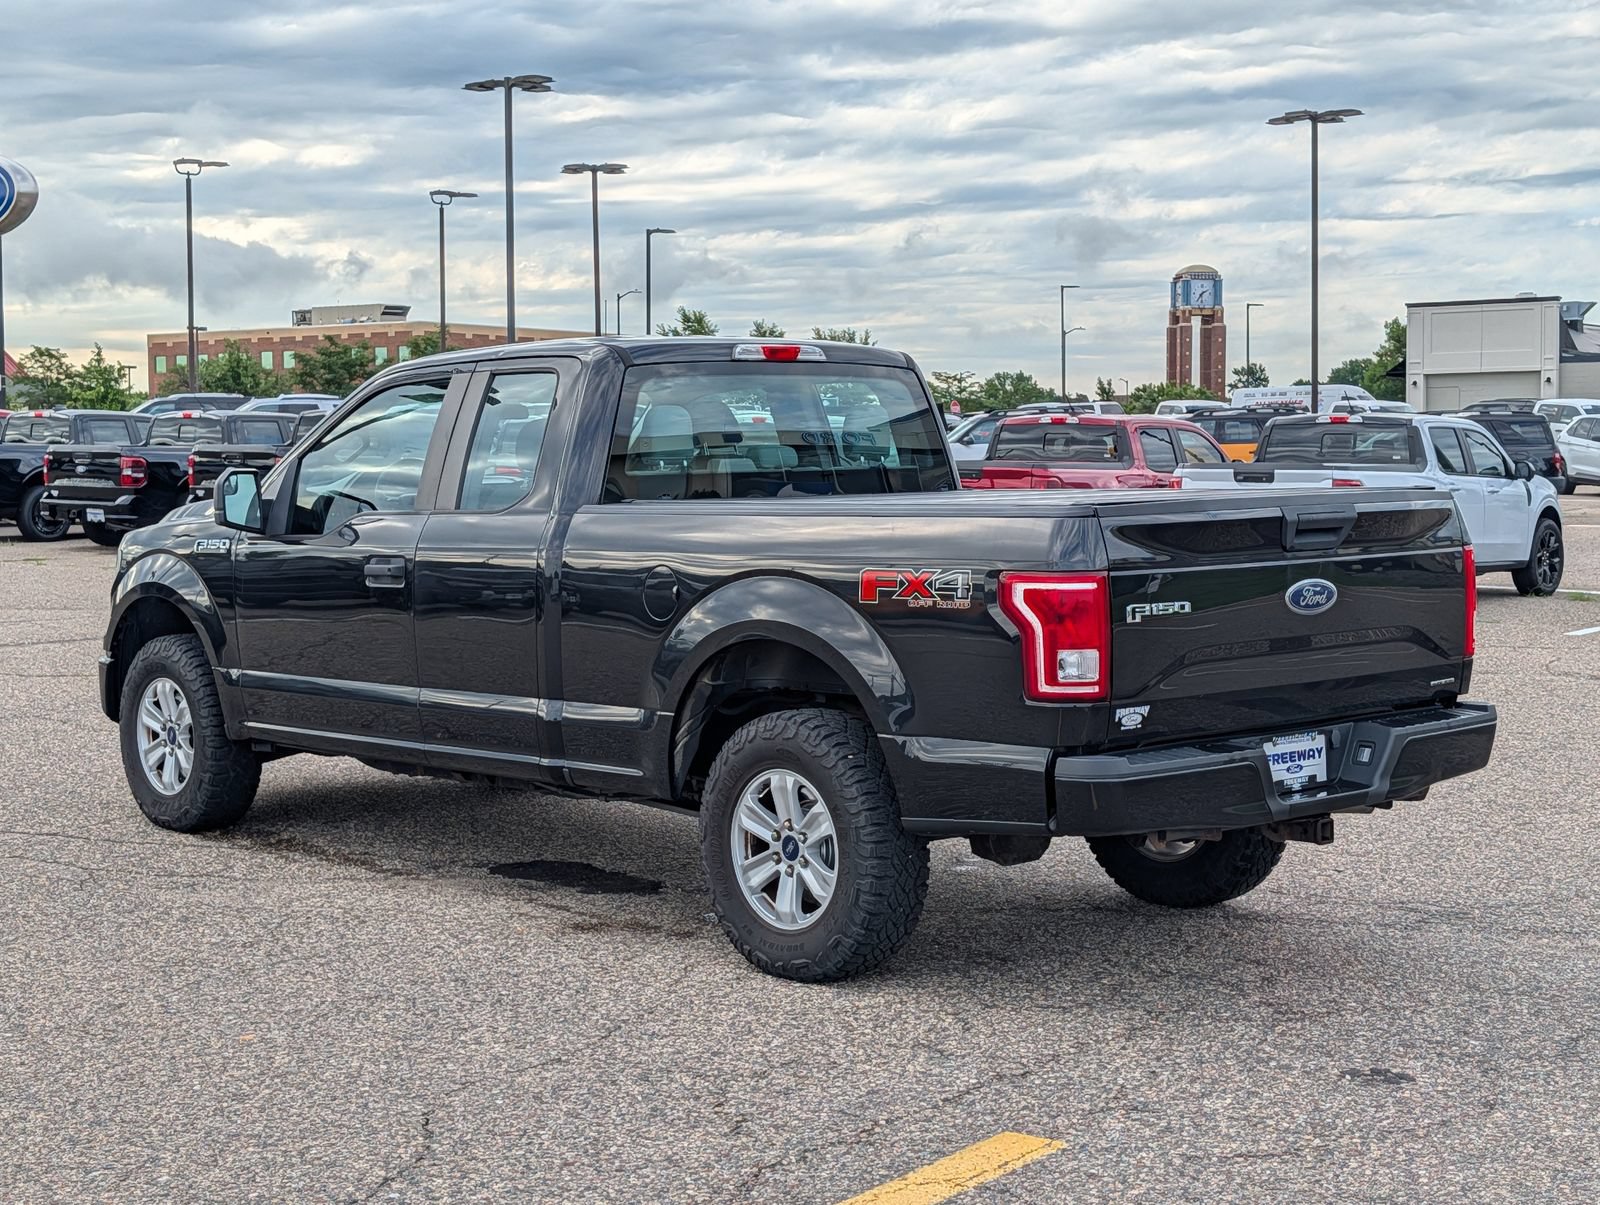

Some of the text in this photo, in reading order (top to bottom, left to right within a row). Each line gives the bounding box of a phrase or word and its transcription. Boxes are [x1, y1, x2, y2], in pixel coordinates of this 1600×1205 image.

[859, 567, 973, 604] FX4
[936, 600, 971, 609] ROAD
[1115, 705, 1151, 722] FREEWAY
[1266, 746, 1324, 766] FREEWAY
